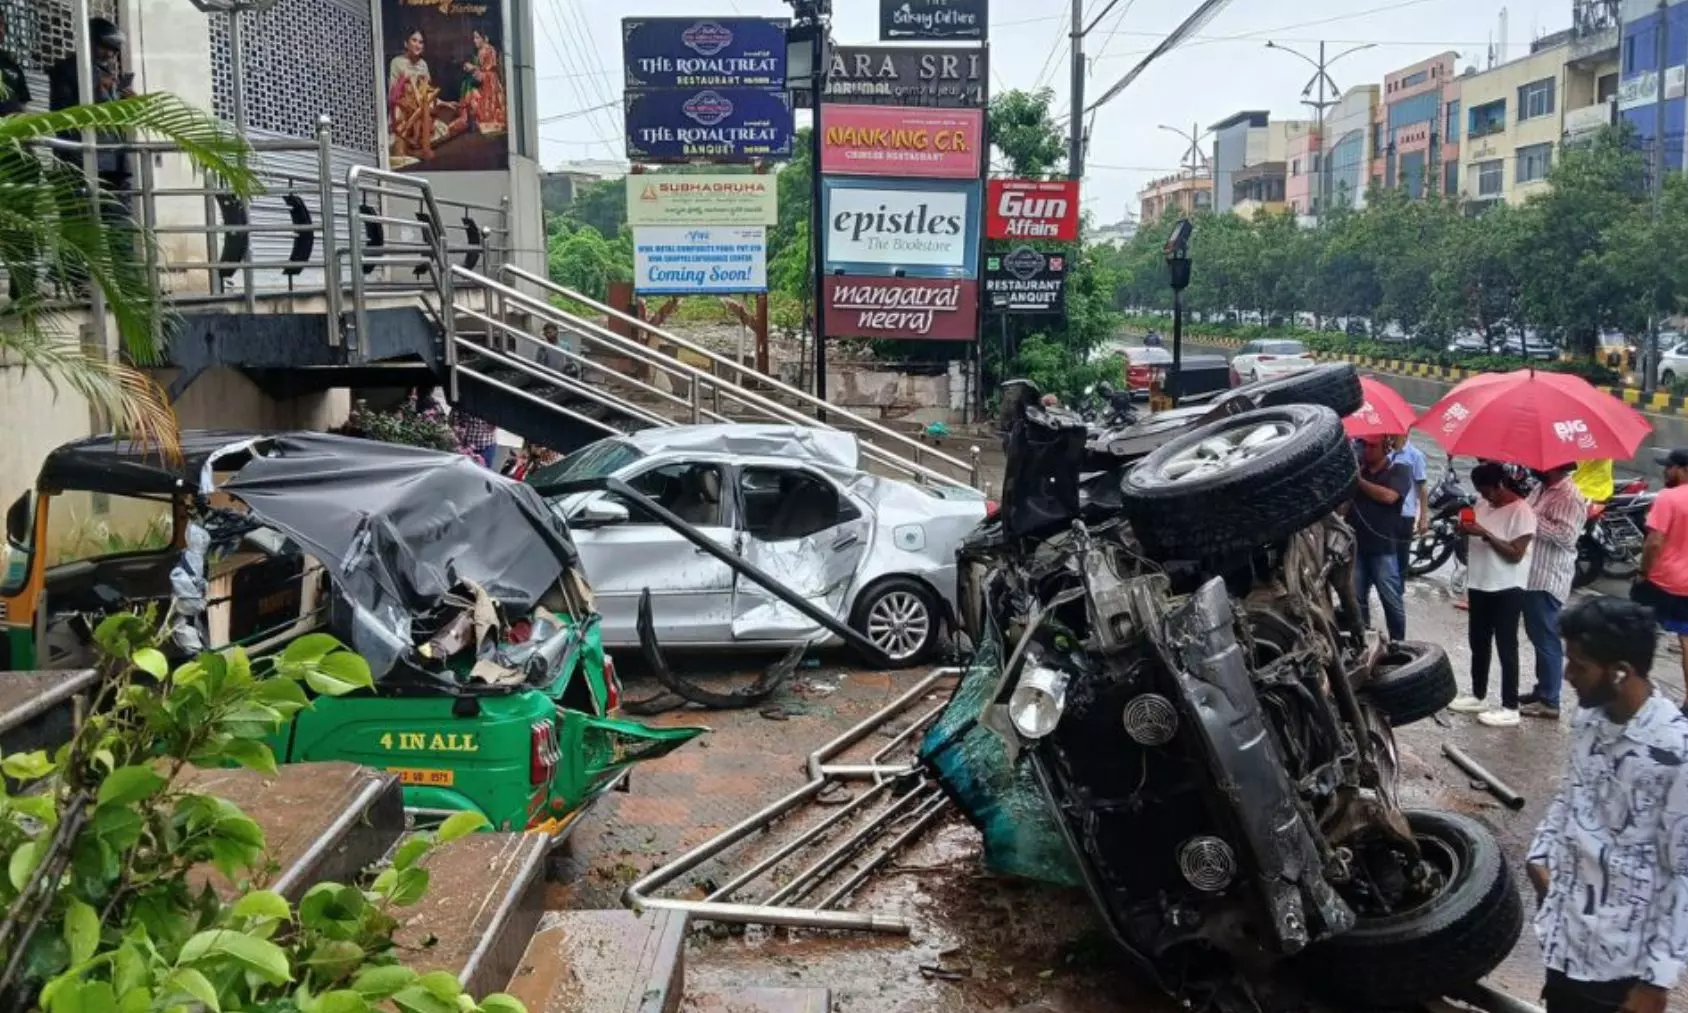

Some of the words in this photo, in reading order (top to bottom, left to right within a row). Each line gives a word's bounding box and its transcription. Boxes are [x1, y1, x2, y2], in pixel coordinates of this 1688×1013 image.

[893, 11, 932, 29] Baking
[935, 11, 976, 25] Culture
[638, 57, 673, 73] THE
[677, 58, 731, 75] ROYAL
[725, 58, 778, 72] TREAT
[920, 54, 980, 79] SRI
[677, 76, 740, 85] RESTAURANT
[639, 126, 673, 143] THE
[677, 128, 731, 144] ROYAL
[725, 128, 778, 141] TREAT
[827, 126, 928, 149] NANKING
[683, 144, 735, 155] BANQUET
[845, 151, 884, 160] CHINESE
[887, 152, 943, 161] RESTAURANT
[659, 183, 766, 193] SUBHAGRUHA
[999, 191, 1067, 218] Gun
[834, 203, 961, 241] epistles
[1004, 219, 1059, 236] Affairs
[868, 236, 889, 250] The
[893, 238, 951, 252] Bookstore
[648, 265, 705, 285] Coming
[709, 265, 752, 282] Soon!
[987, 280, 1062, 291] RESTAURANT
[833, 285, 961, 306] mangatrai
[1008, 292, 1056, 303] ANQUET
[858, 310, 933, 334] neeraj
[1553, 419, 1588, 436] BIG
[380, 733, 393, 749] 4
[399, 733, 426, 750] IN
[428, 734, 479, 751] ALL
